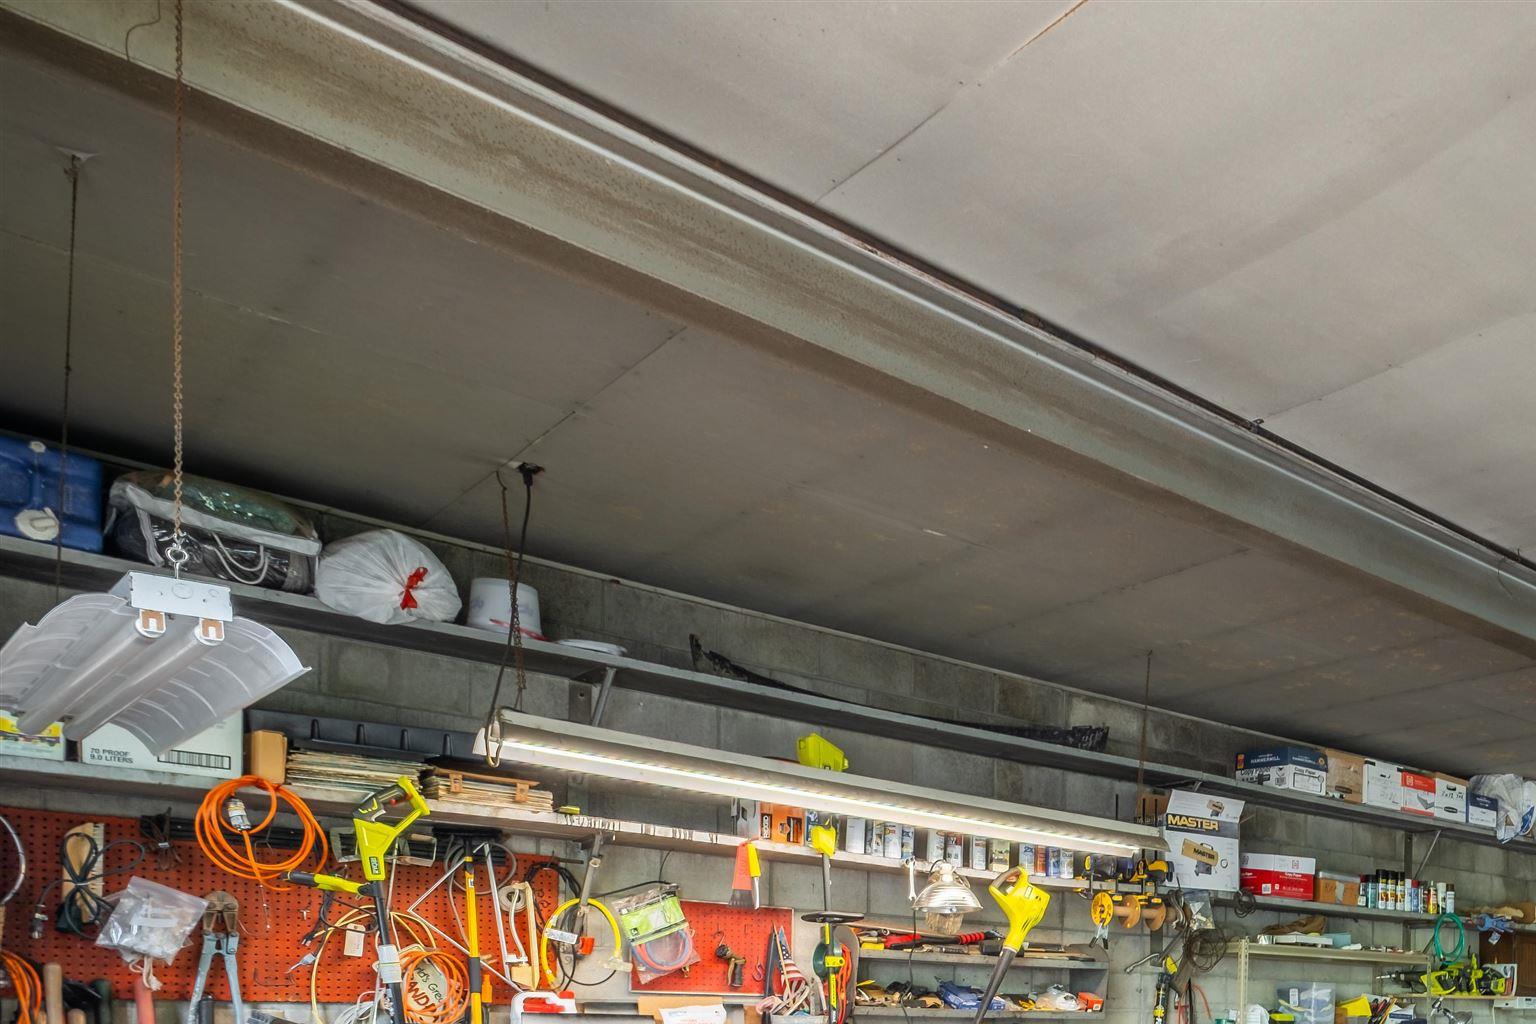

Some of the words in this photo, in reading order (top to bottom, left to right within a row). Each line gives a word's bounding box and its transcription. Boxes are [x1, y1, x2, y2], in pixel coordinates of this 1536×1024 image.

[105, 755, 134, 764] LITERS
[1167, 814, 1219, 831] MASTER
[1193, 848, 1215, 860] MASTER
